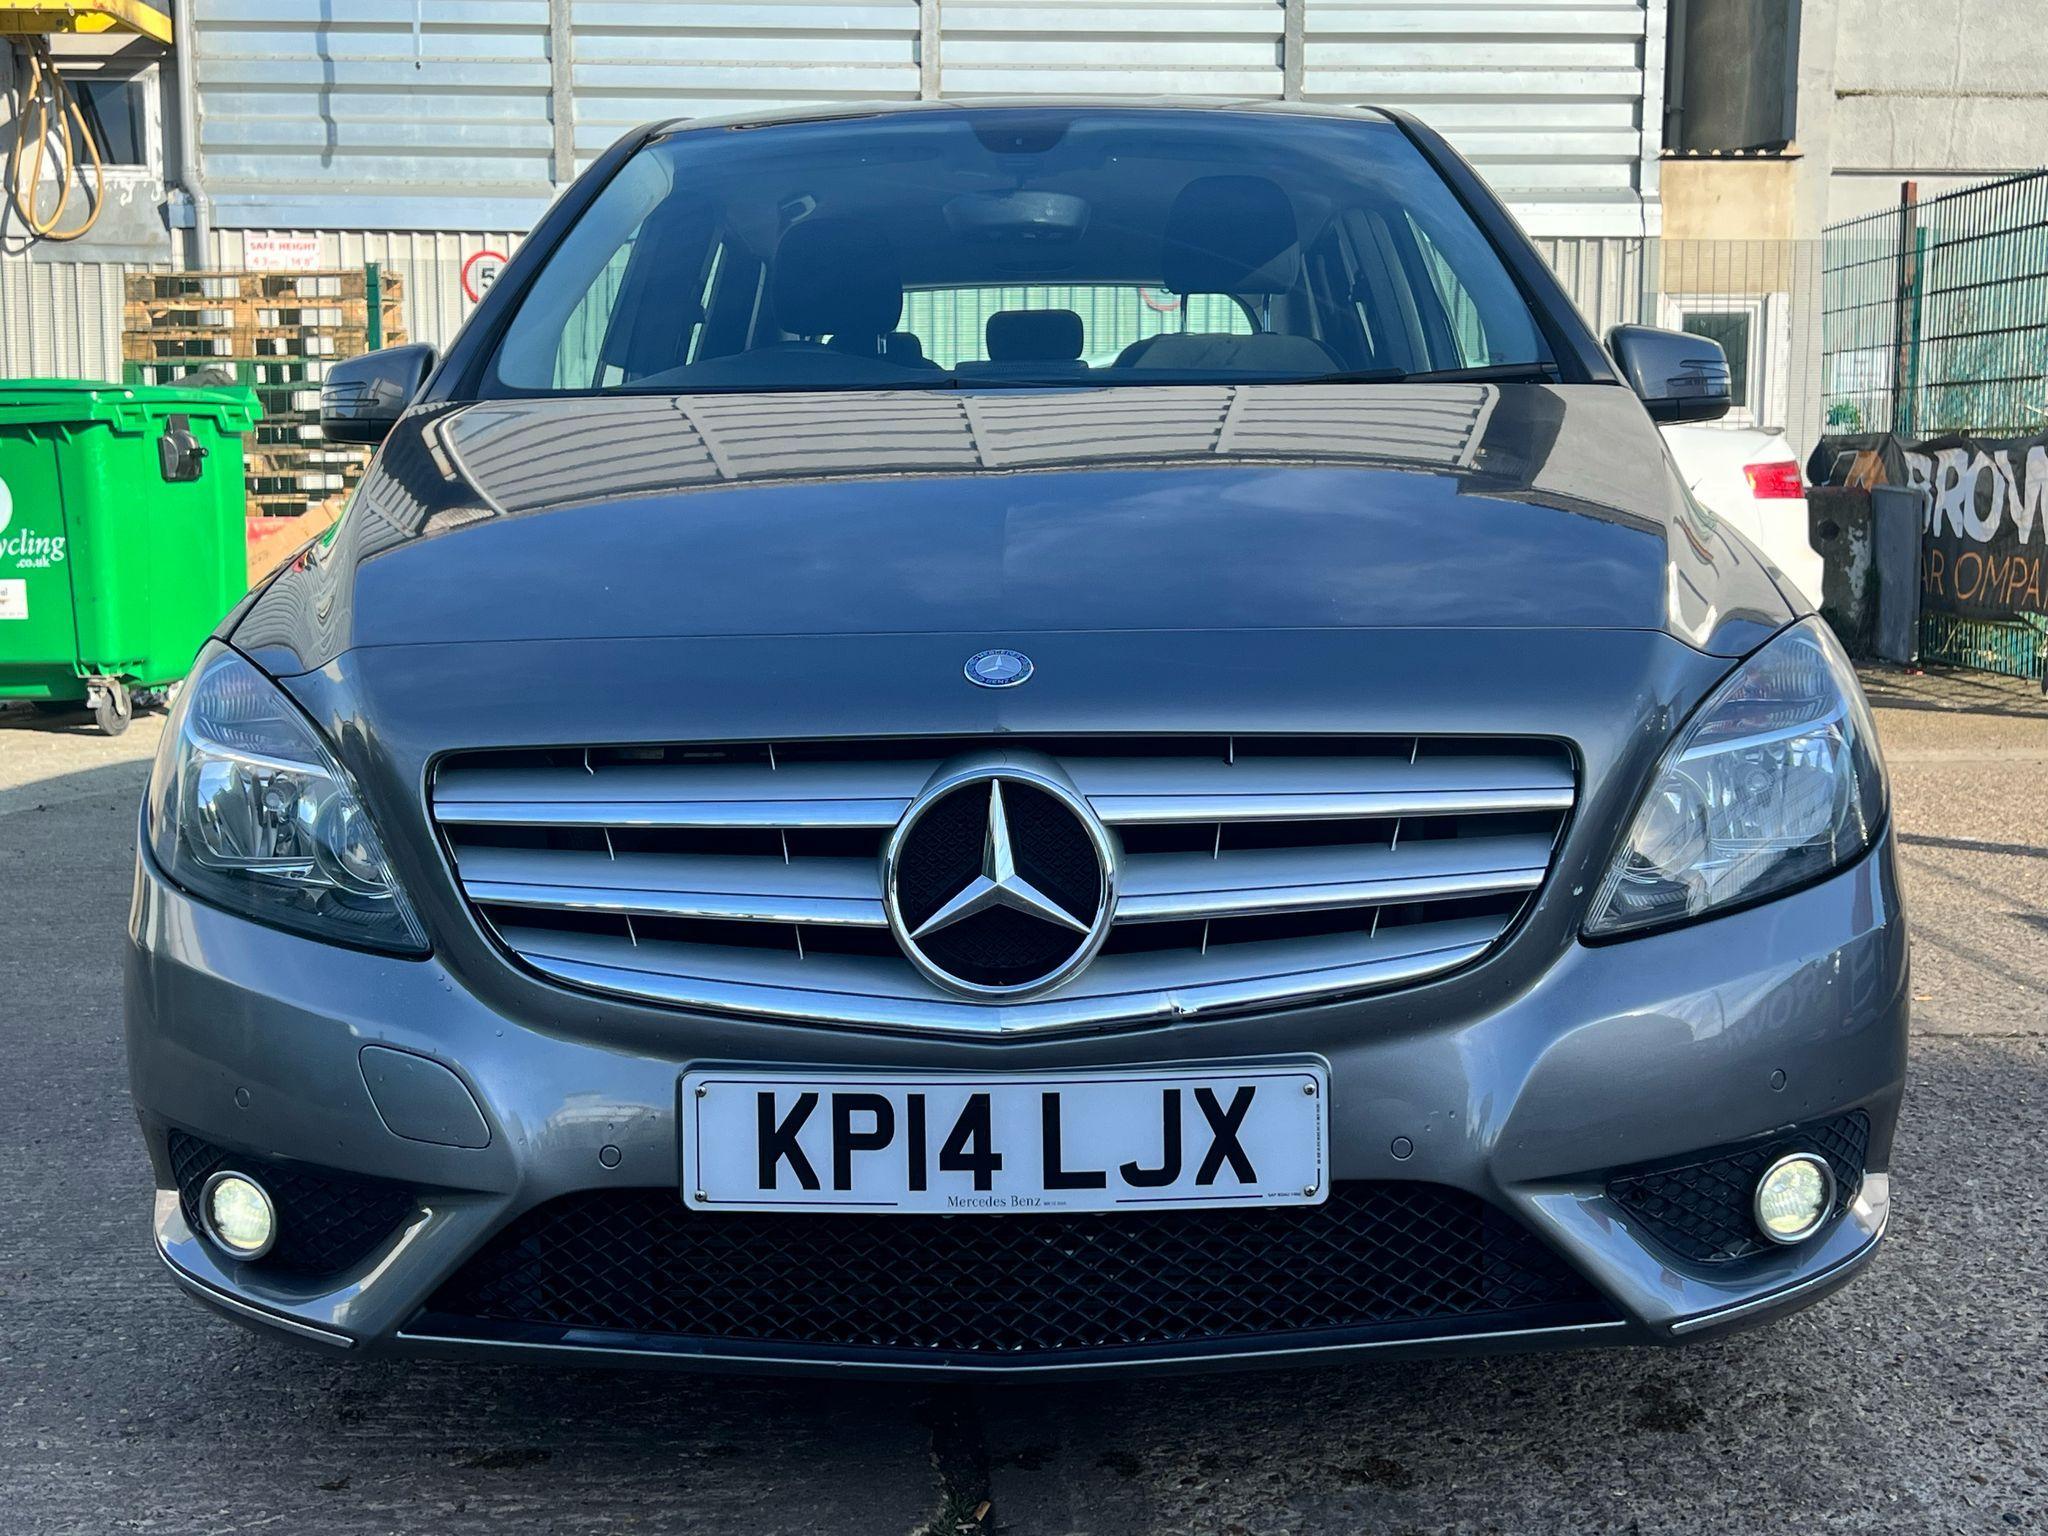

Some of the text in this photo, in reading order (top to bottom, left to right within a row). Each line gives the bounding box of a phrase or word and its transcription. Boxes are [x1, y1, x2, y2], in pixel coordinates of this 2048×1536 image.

[250, 242, 316, 250] SAFE HEIGHT
[756, 1091, 1003, 1191] KP14
[1041, 1085, 1258, 1190] LJX
[947, 1195, 1041, 1208] Mercedes Benz
